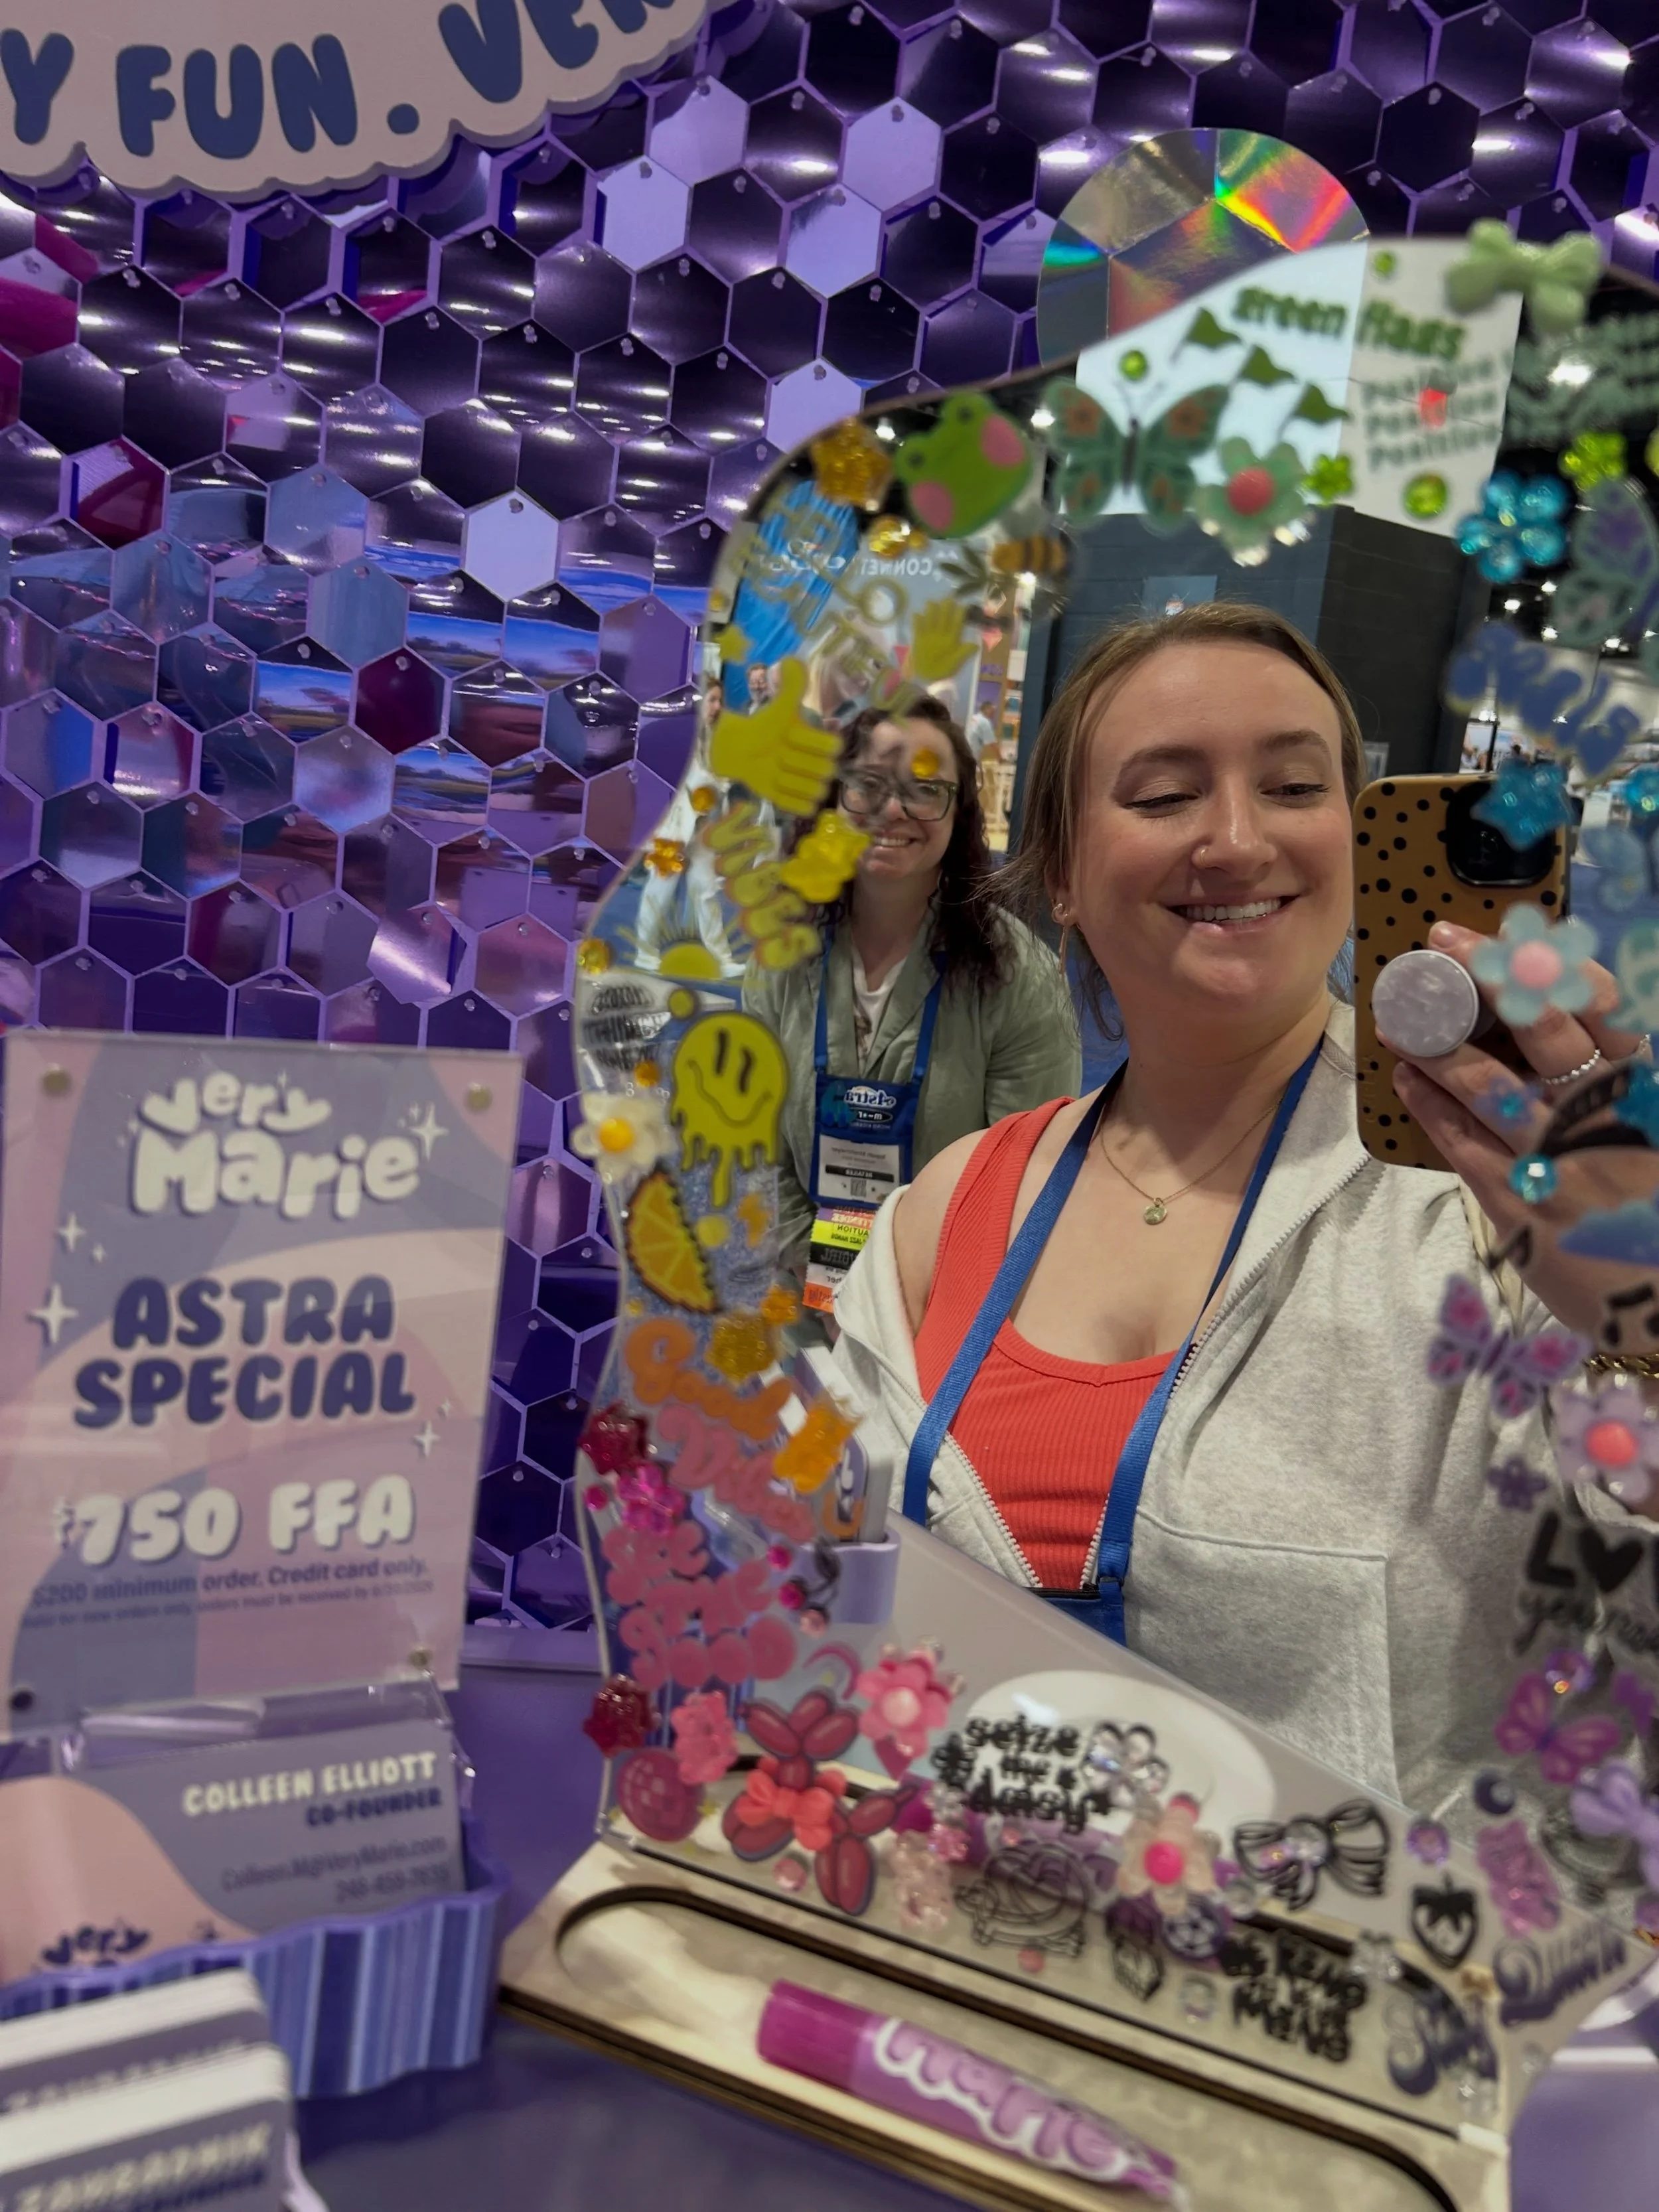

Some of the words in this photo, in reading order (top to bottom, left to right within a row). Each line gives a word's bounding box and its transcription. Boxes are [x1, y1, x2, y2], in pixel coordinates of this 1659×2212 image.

[115, 33, 420, 159] FUN.
[132, 1128, 421, 1218] Marie
[112, 1274, 395, 1351] ASTRA
[73, 1351, 415, 1430] SPECIAL
[53, 1487, 242, 1567] $750
[269, 1474, 417, 1554] FFA
[93, 1574, 197, 1601] minimum
[268, 1562, 330, 1586] Credit
[334, 1557, 380, 1580] card
[182, 1767, 314, 1818] COLLEEN
[322, 1751, 437, 1796] ELLIOTT
[305, 1785, 441, 1828] CO-FOUNDER
